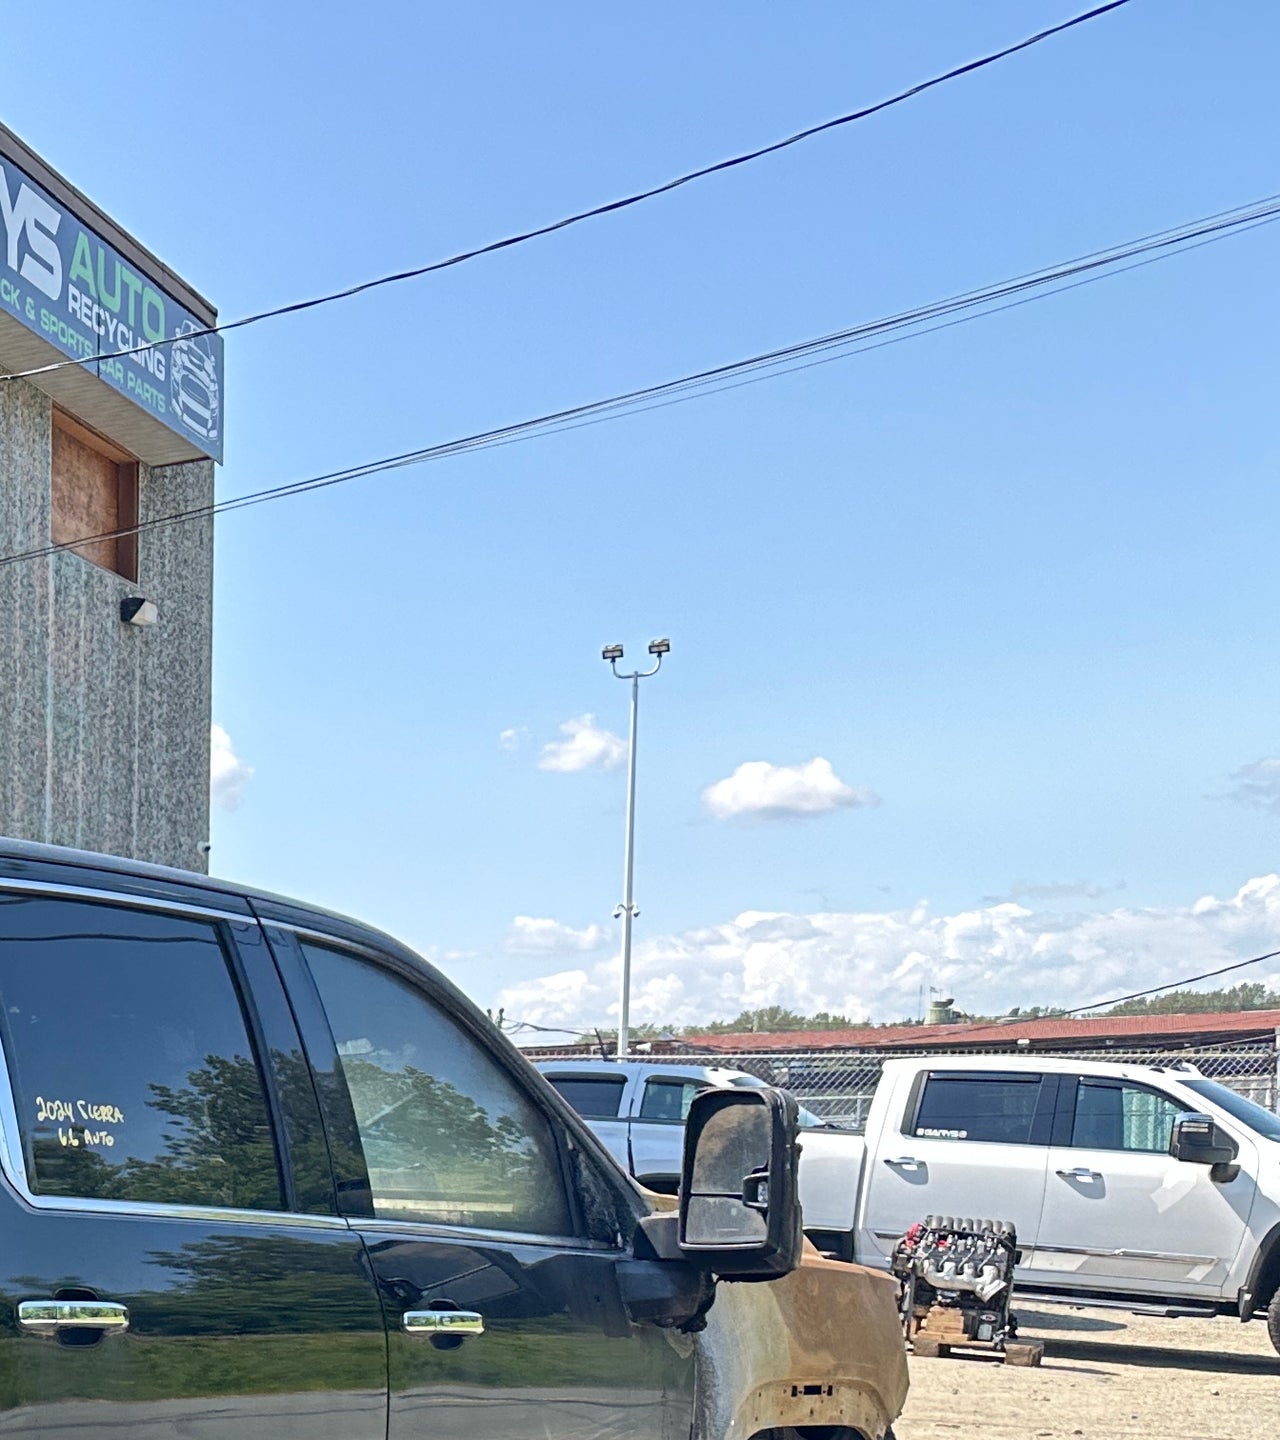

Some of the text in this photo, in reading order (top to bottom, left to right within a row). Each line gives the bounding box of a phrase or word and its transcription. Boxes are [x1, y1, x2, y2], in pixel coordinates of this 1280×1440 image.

[68, 283, 166, 382] RECYCLING
[69, 231, 166, 343] AUTO
[25, 296, 36, 320] &
[40, 308, 94, 358] SPORTS
[99, 350, 124, 384] CAR
[127, 370, 166, 413] PARTS
[36, 1096, 75, 1123] 2024
